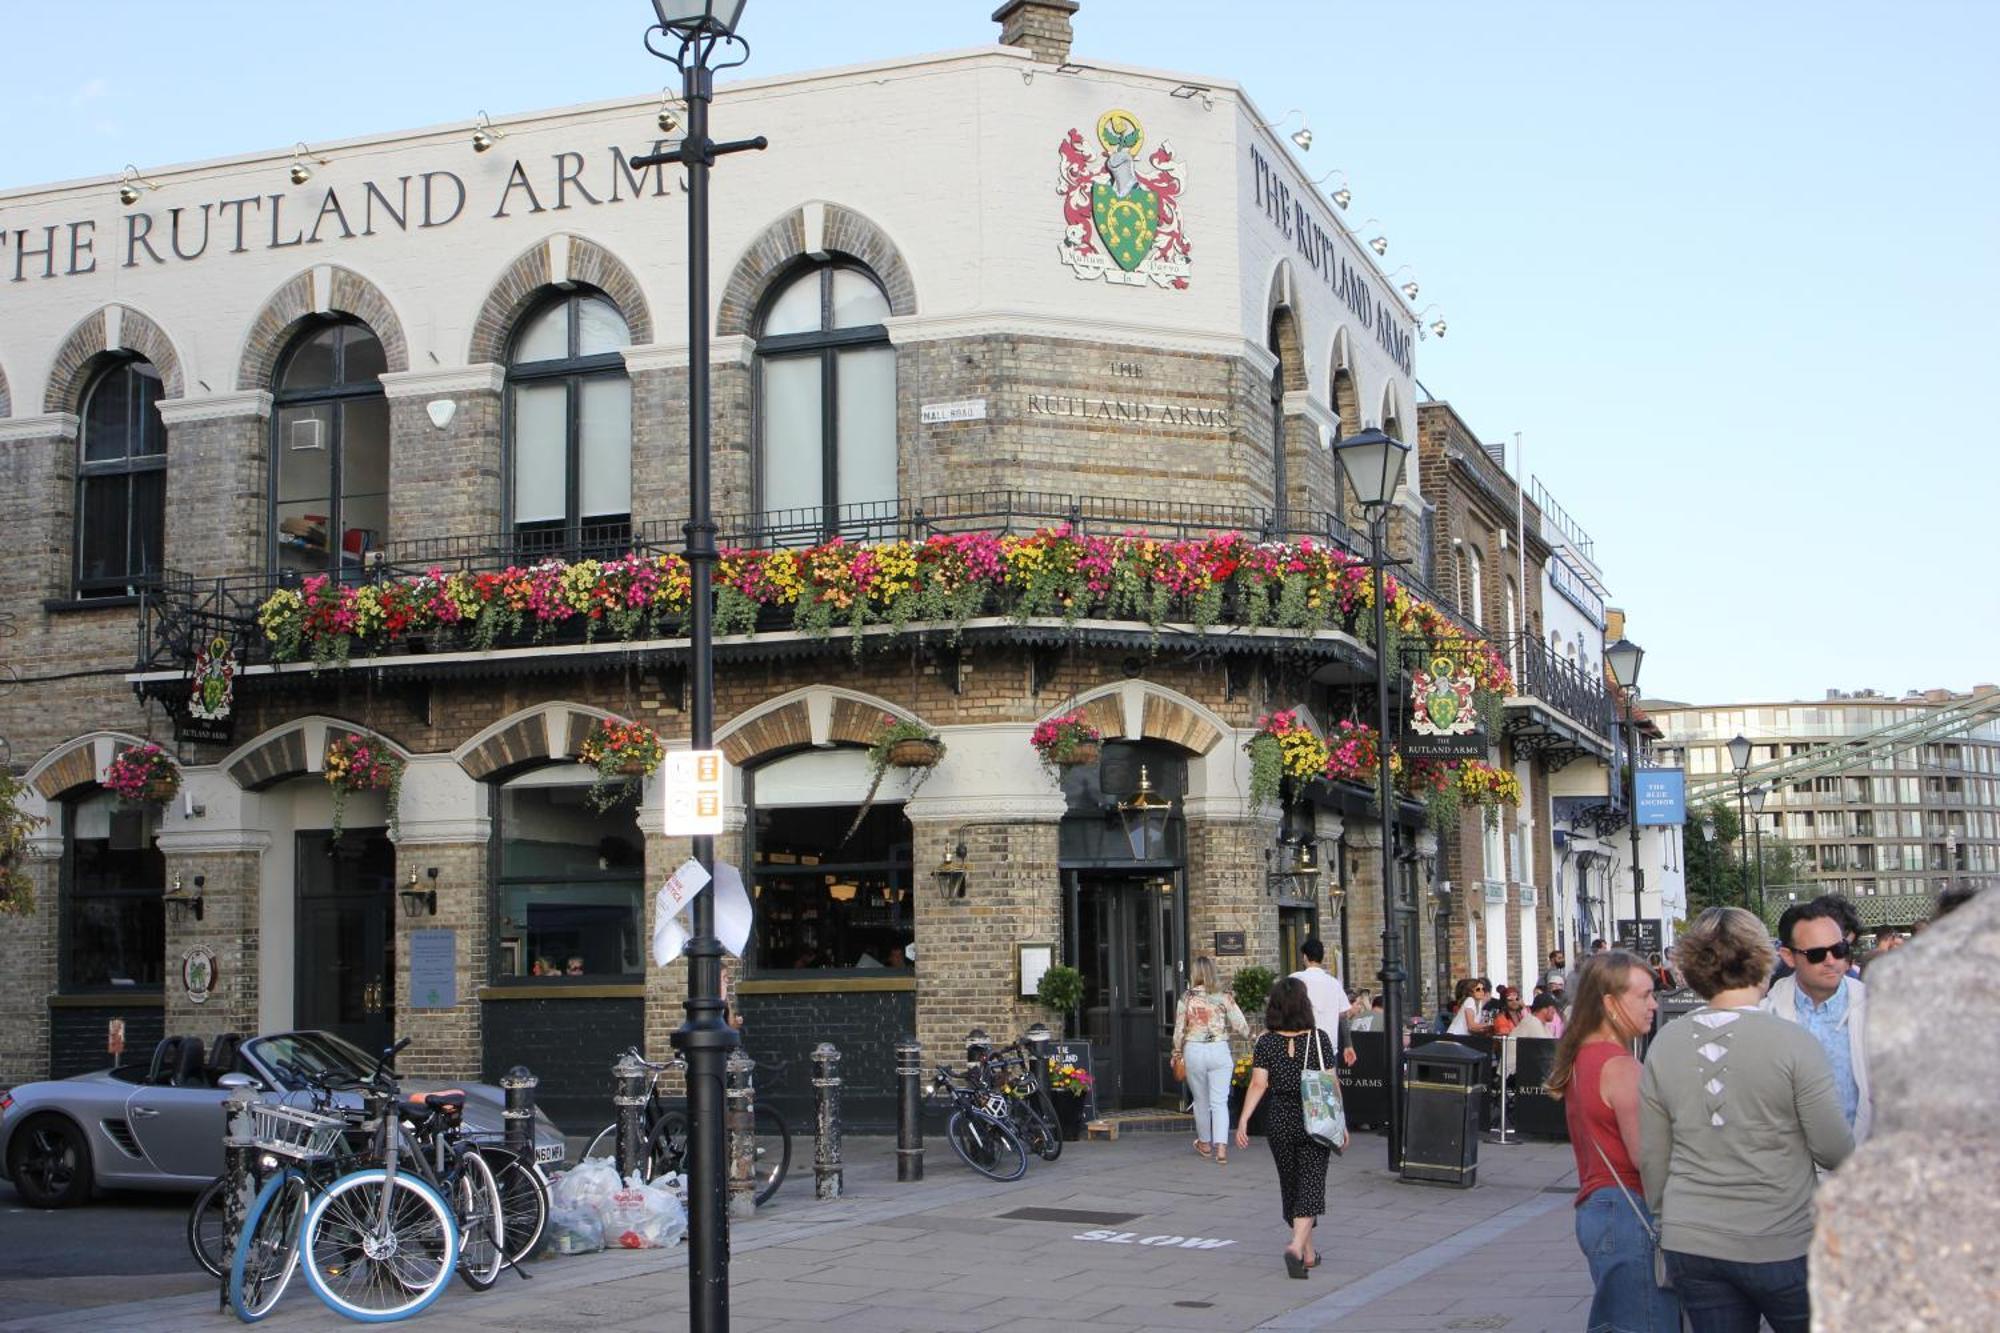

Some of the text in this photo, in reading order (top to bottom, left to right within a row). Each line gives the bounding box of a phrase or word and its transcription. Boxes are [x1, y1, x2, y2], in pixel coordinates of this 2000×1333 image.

[0, 220, 96, 282] HE
[122, 171, 466, 267] RUTLAND
[1251, 143, 1411, 378] THE RUTLAND ARMS
[1110, 361, 1143, 378] THE
[1027, 394, 1229, 429] RUTLAND ARMS
[1408, 745, 1479, 754] RUTLAND ARMS
[1437, 737, 1450, 745] THE
[1355, 1079, 1383, 1087] ARMS
[1519, 1086, 1547, 1096] RUTL
[1072, 1229, 1238, 1249] SLOW
